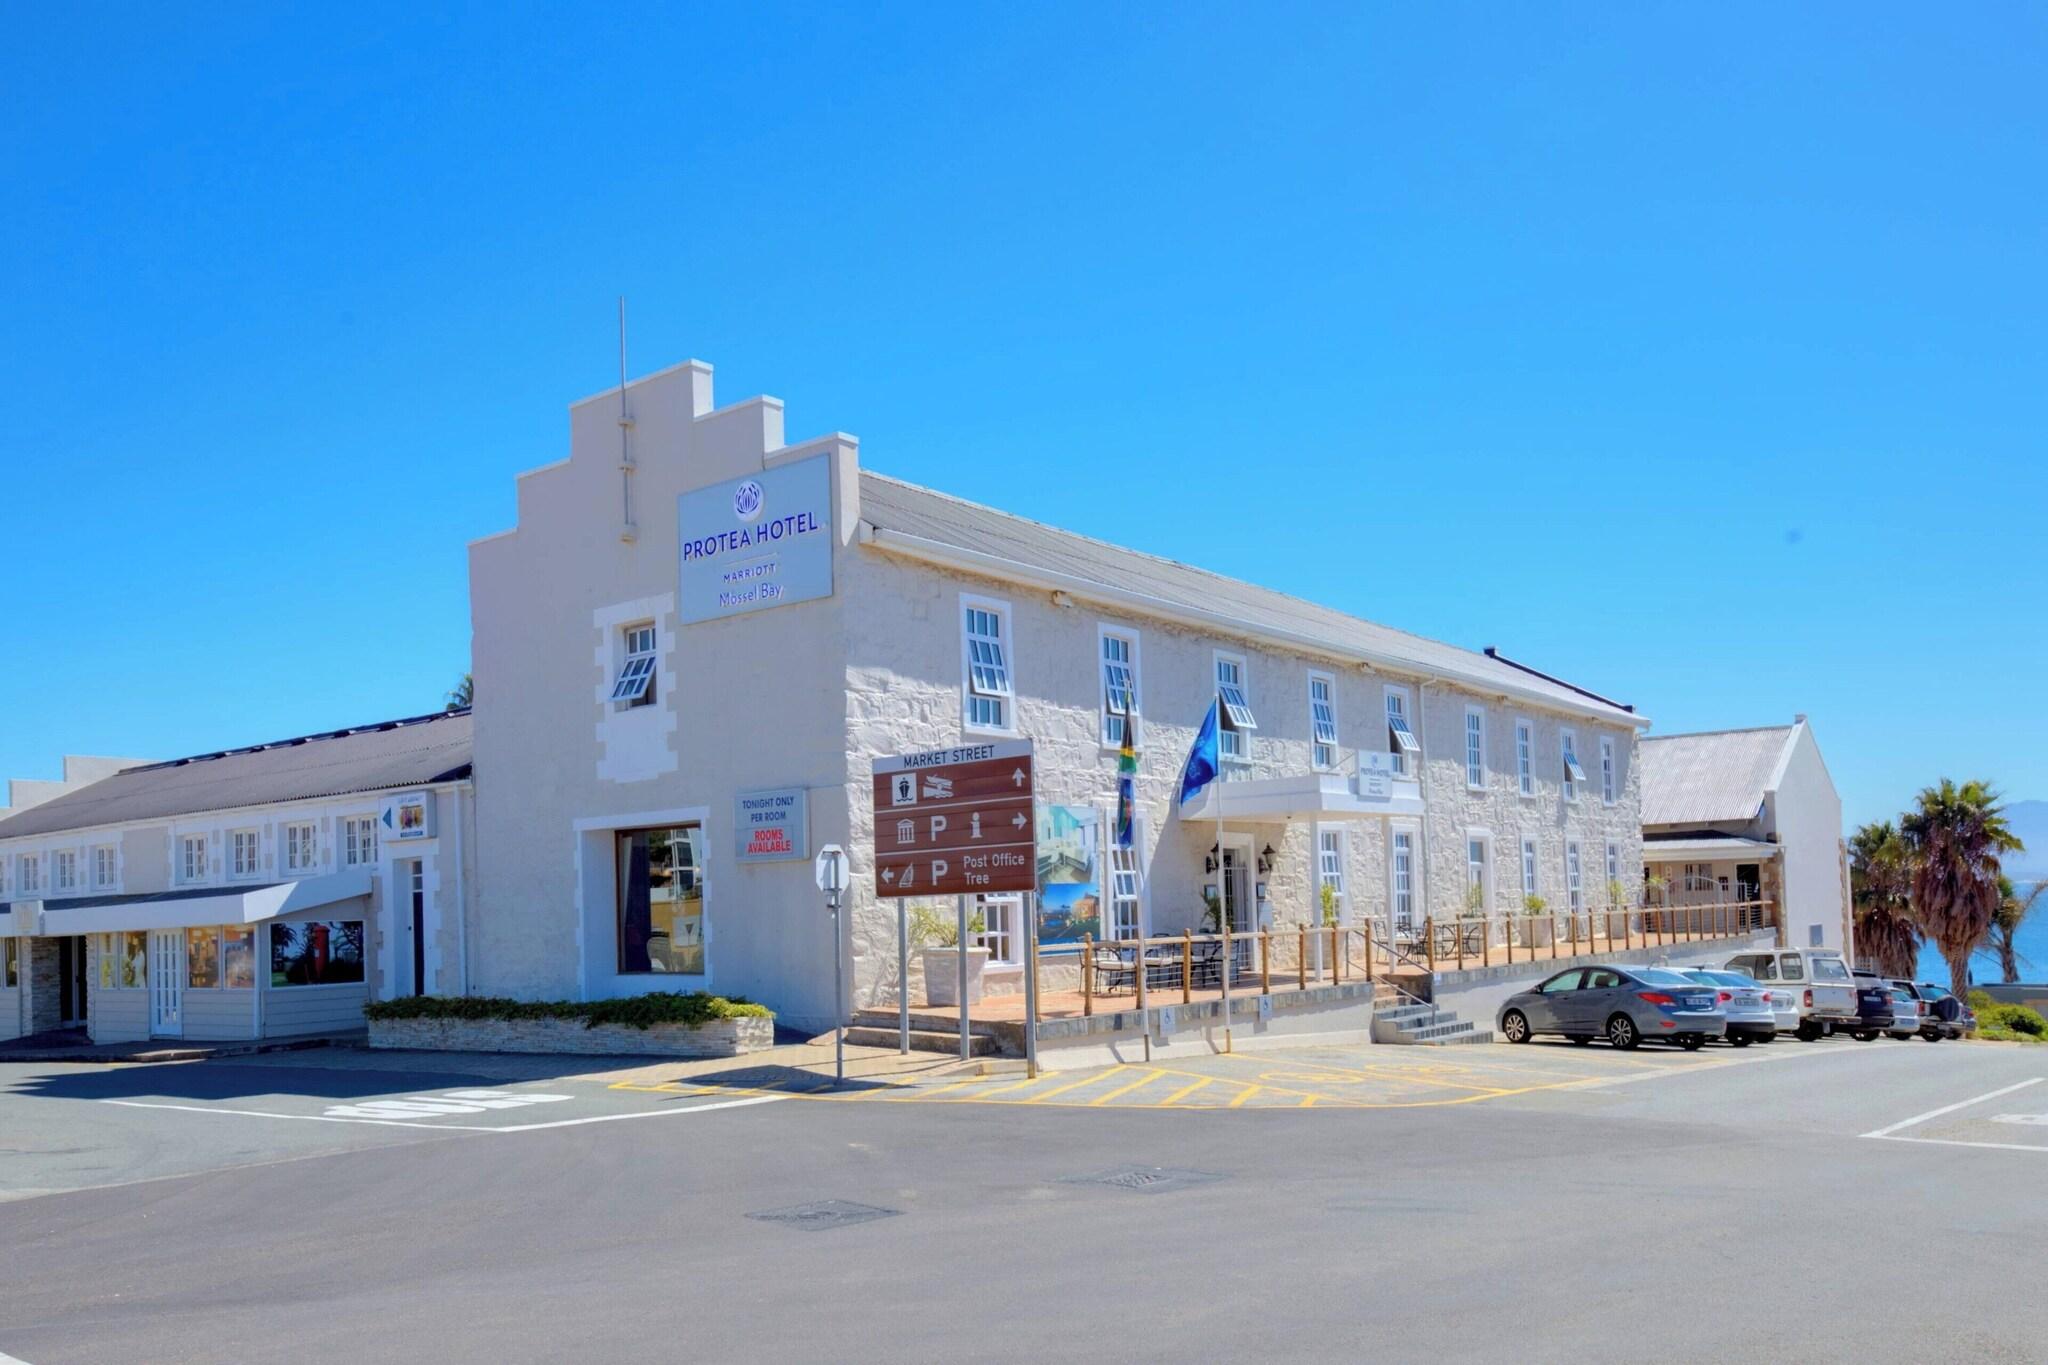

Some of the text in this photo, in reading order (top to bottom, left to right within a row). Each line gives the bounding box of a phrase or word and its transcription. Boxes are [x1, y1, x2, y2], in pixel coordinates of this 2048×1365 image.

[683, 511, 818, 561] PROTEA HOTEL
[723, 563, 776, 583] MARRIOTT
[719, 582, 783, 607] Mossel Bay
[904, 745, 995, 768] MARKET STREET
[742, 796, 794, 810] TONIGHT ONLY
[751, 811, 786, 823] PER ROOM
[754, 829, 783, 840] ROOMS
[931, 815, 947, 842] P
[748, 841, 791, 853] AVAILABLE
[963, 852, 1025, 868] Post Office
[931, 859, 948, 886] P
[964, 872, 990, 885] Tree
